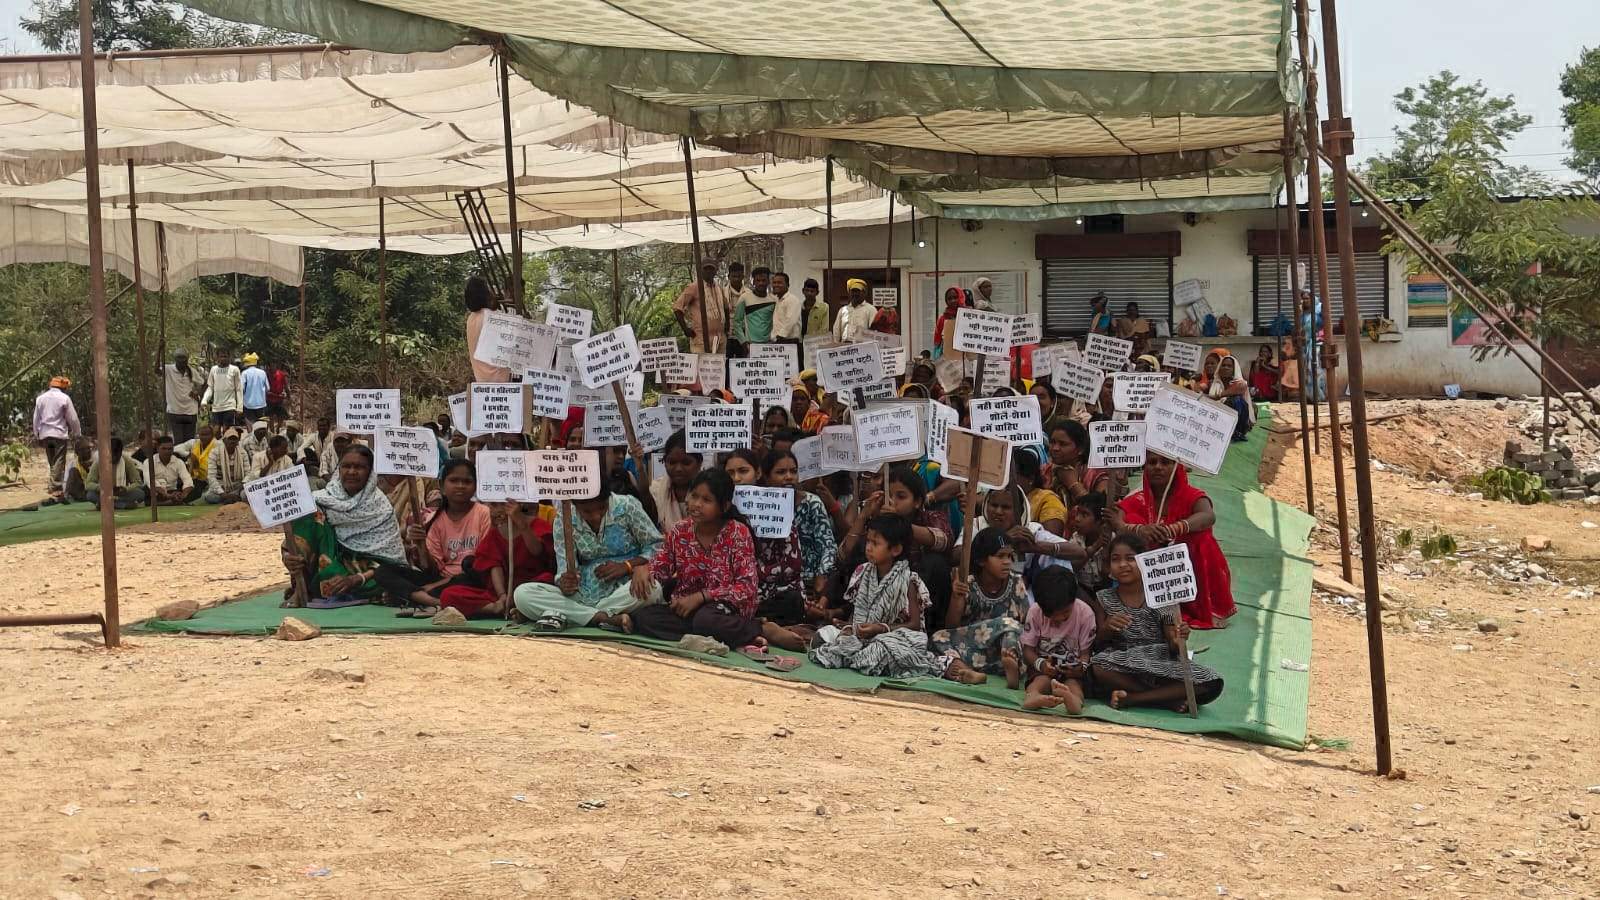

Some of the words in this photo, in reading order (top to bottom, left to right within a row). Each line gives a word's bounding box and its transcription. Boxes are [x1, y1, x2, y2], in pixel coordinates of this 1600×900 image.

[994, 400, 1018, 409] चाहिए
[692, 419, 716, 427] भविष्य
[980, 423, 992, 433] हमें
[995, 422, 1019, 431] चाहिए
[1109, 423, 1130, 432] चाहिए
[712, 432, 735, 440] दुकान
[538, 465, 554, 473] 740
[1147, 567, 1166, 578] भविष्य
[1165, 577, 1182, 591] दुकान
